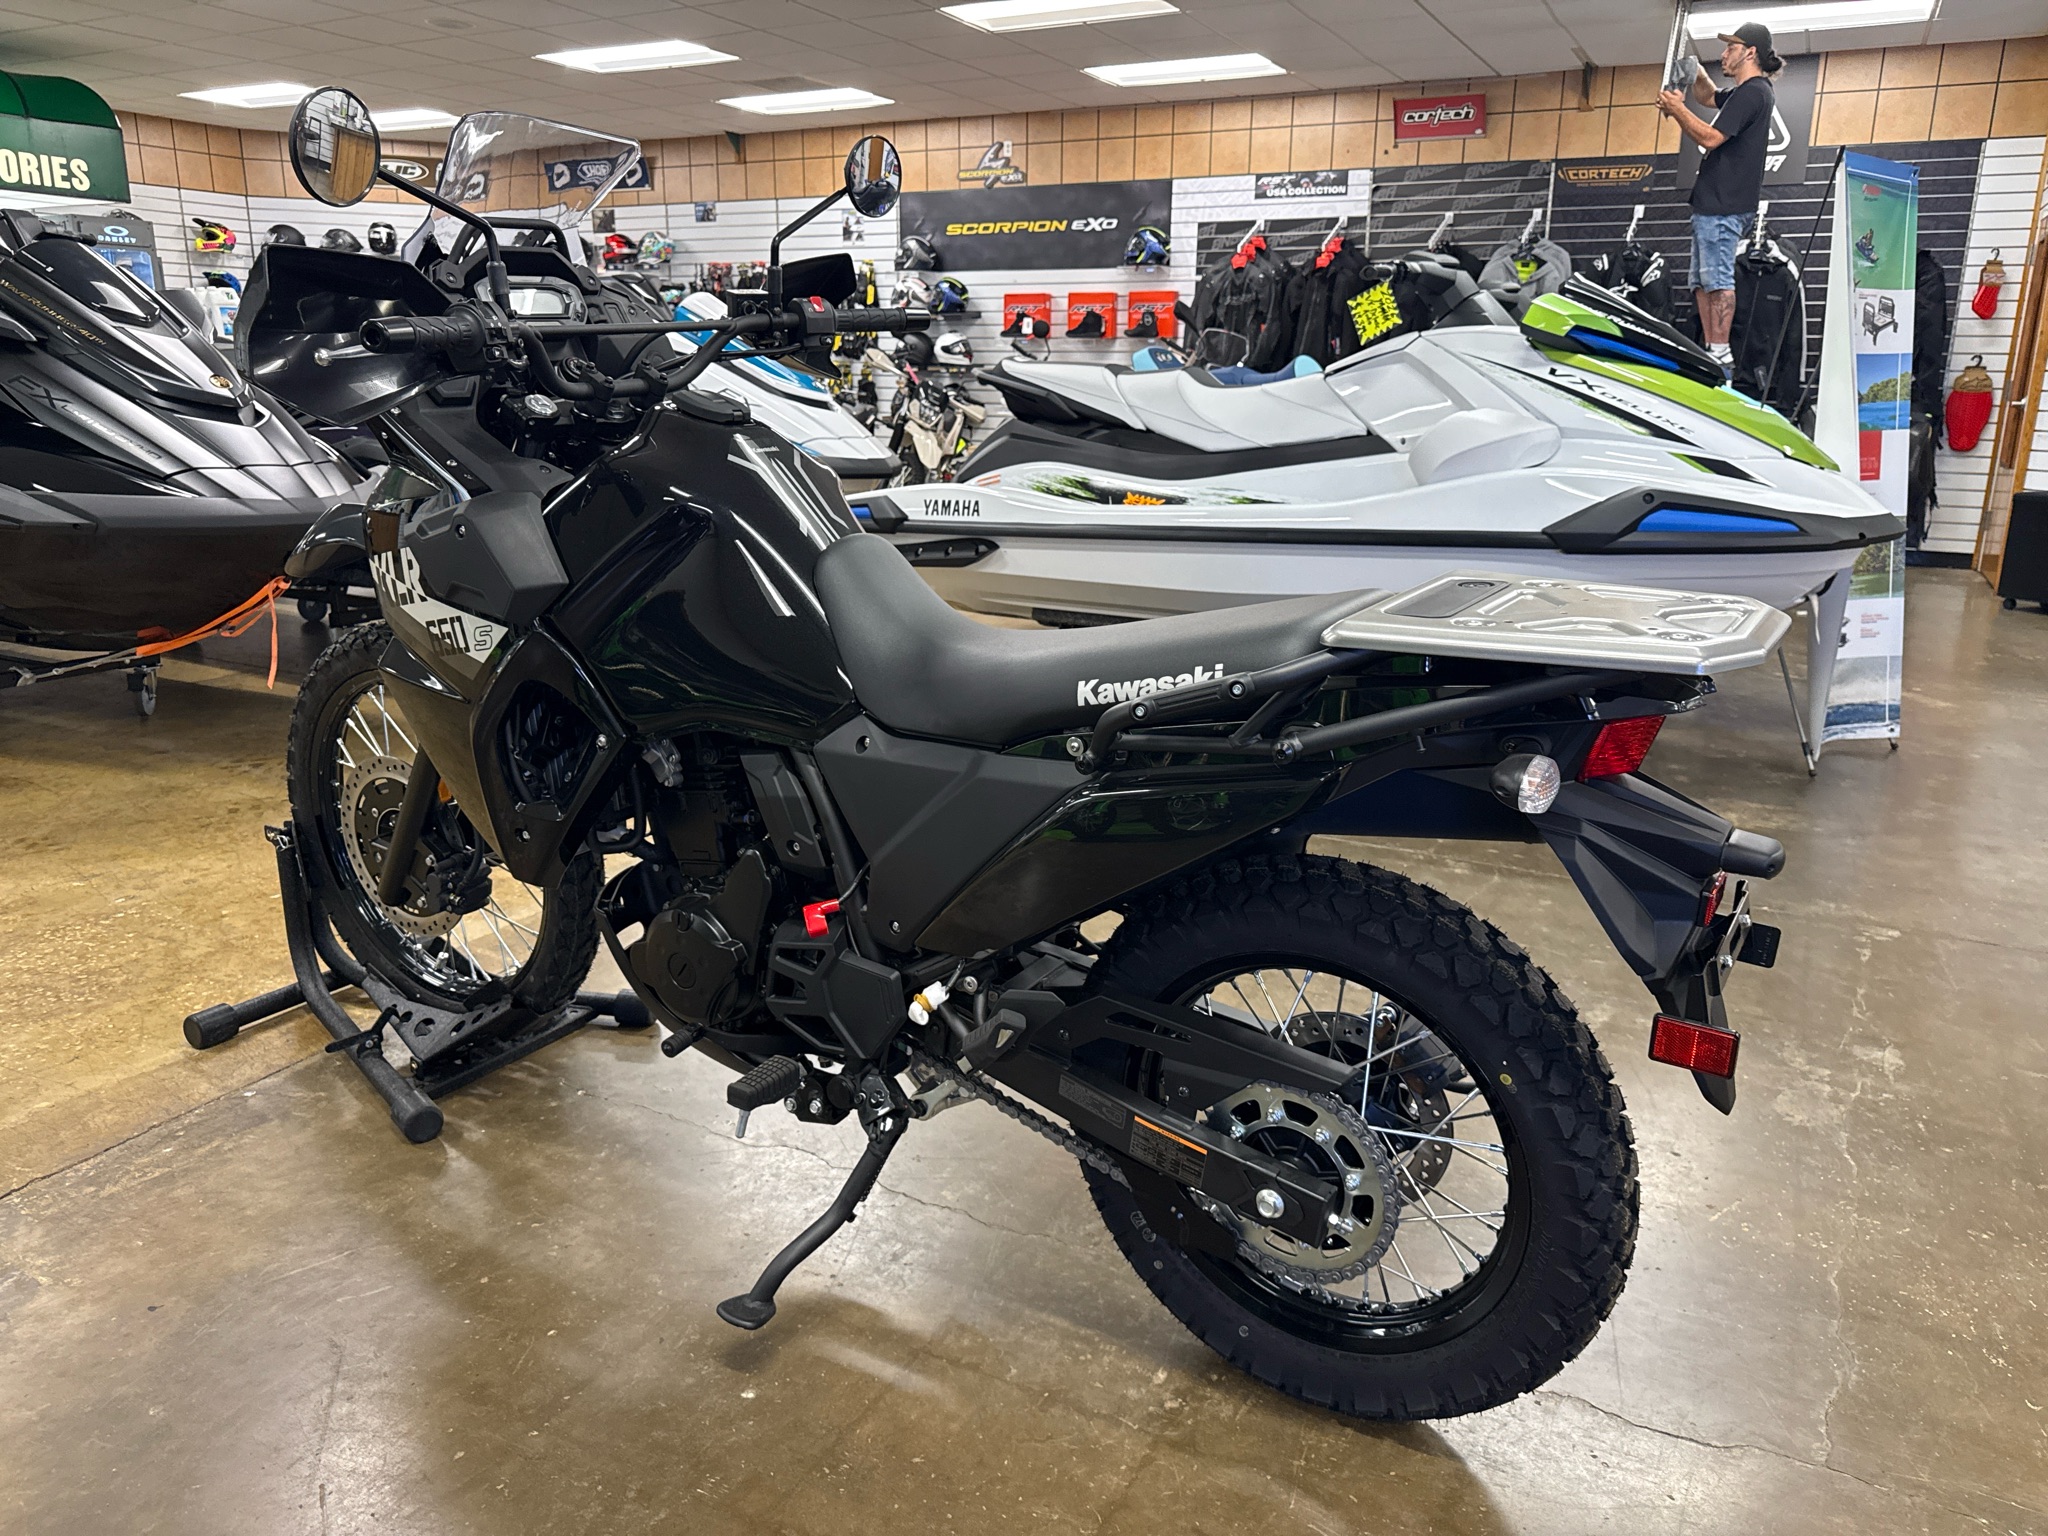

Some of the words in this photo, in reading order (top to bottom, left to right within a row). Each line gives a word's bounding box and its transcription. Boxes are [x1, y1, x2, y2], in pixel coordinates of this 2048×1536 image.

[1403, 105, 1475, 126] cortech
[959, 168, 1014, 179] SCORPION
[1567, 167, 1643, 180] CORTECH
[1266, 187, 1287, 197] USA
[1288, 185, 1347, 196] COLLECTION
[946, 219, 1069, 236] SCORPION
[97, 234, 137, 244] OAKLEY
[1004, 303, 1044, 313] RST
[1069, 303, 1113, 313] RST
[1130, 302, 1174, 312] RST
[8, 375, 73, 410] FX
[1549, 367, 1605, 392] VX
[1600, 391, 1695, 434] DELUXE
[924, 499, 980, 516] YAMAHA
[368, 546, 428, 607] KLR
[425, 615, 471, 657] 650
[1077, 663, 1224, 706] Kawasaki
